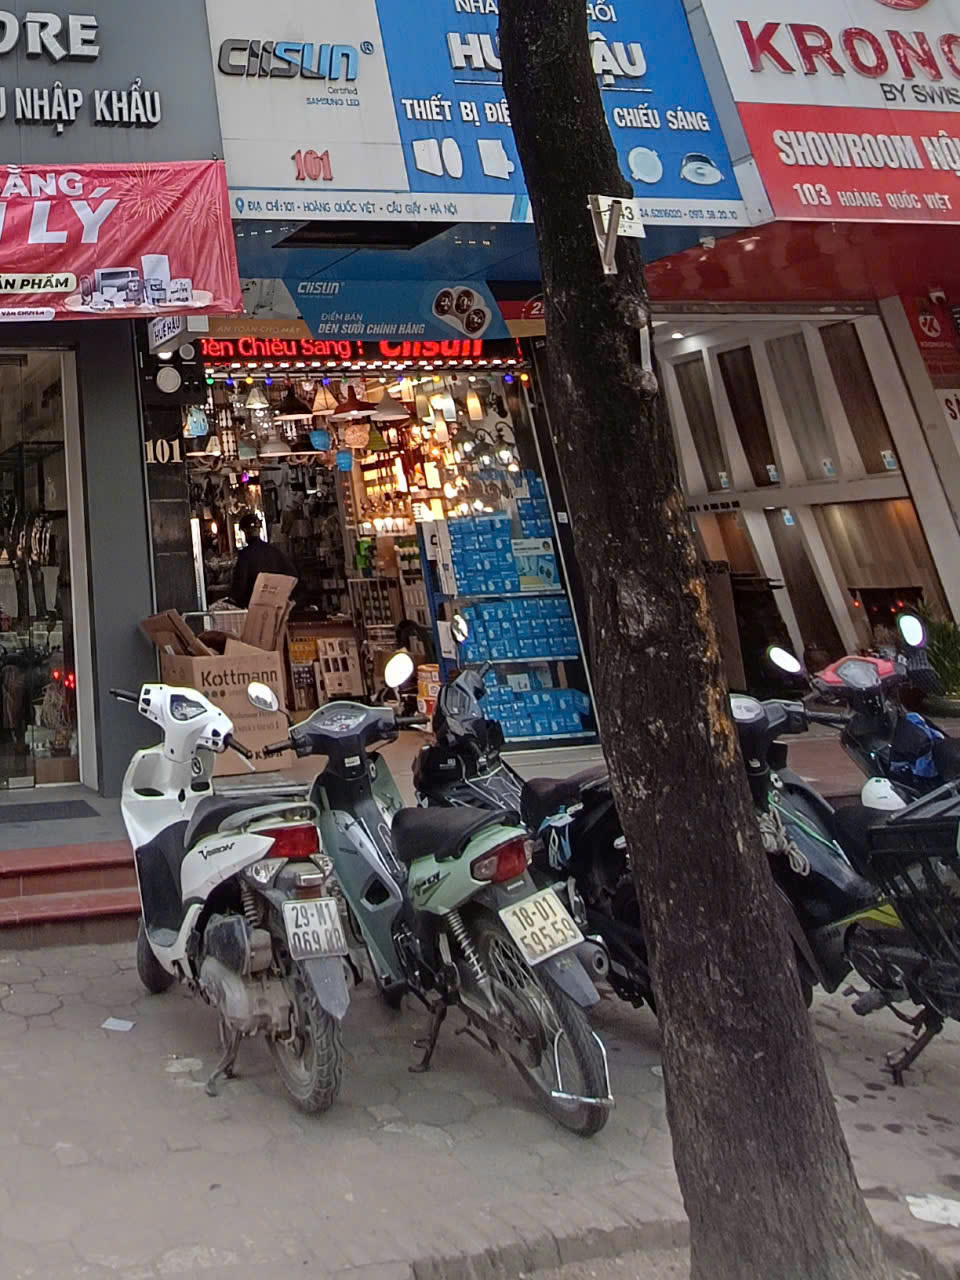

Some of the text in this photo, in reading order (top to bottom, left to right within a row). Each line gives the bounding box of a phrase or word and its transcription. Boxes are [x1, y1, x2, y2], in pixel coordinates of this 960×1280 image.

[589, 31, 647, 87] ẬU
[15, 80, 83, 136] NHẬP
[94, 76, 162, 128] KHẨU
[880, 83, 907, 103] BY
[401, 94, 512, 127] THIẾT BỊ ĐIỆ
[614, 103, 711, 132] CHIẾU SÁNG
[773, 130, 924, 169] SHOWROOM
[291, 149, 333, 181] 101
[793, 183, 953, 212] 103 HOÀNG QUỐC VIỆT
[27, 187, 120, 247] LÝ
[19, 274, 70, 291] PHẨM
[366, 321, 396, 335] CHÍNH
[145, 438, 183, 464] 101
[201, 671, 279, 687] Kottmann
